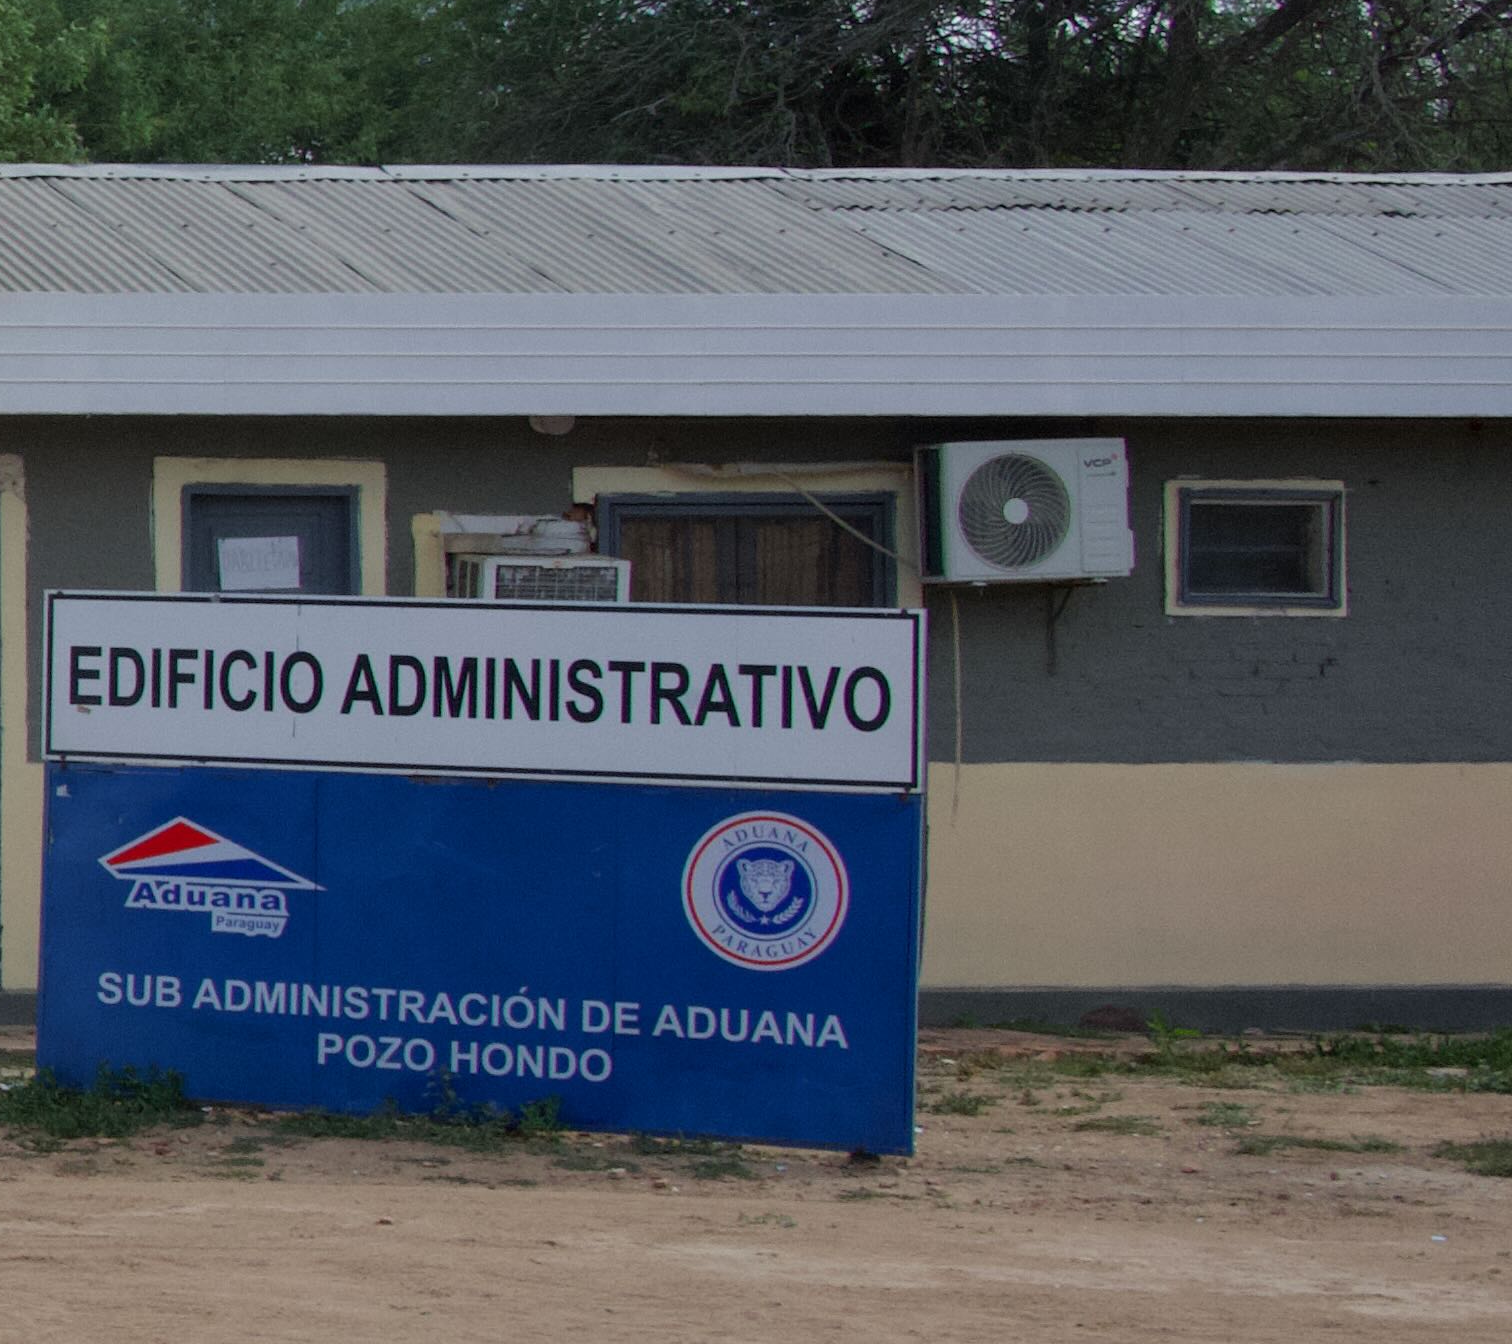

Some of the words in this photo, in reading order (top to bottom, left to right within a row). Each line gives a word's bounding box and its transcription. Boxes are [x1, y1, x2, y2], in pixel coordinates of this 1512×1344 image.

[69, 645, 324, 714] EDIFICIO
[340, 653, 892, 733] ADMINISTRATIVO
[721, 824, 810, 853] ADUANA
[132, 881, 281, 911] Aduana
[215, 915, 281, 932] Paraguay
[712, 924, 817, 958] PARAGUAY
[97, 972, 182, 1007] SUB
[192, 978, 566, 1031] ADMINISTRACIÓN
[582, 999, 641, 1036] DE
[652, 1004, 849, 1049] ADUANA
[317, 1032, 436, 1072] POZO
[450, 1041, 613, 1083] HONDO
